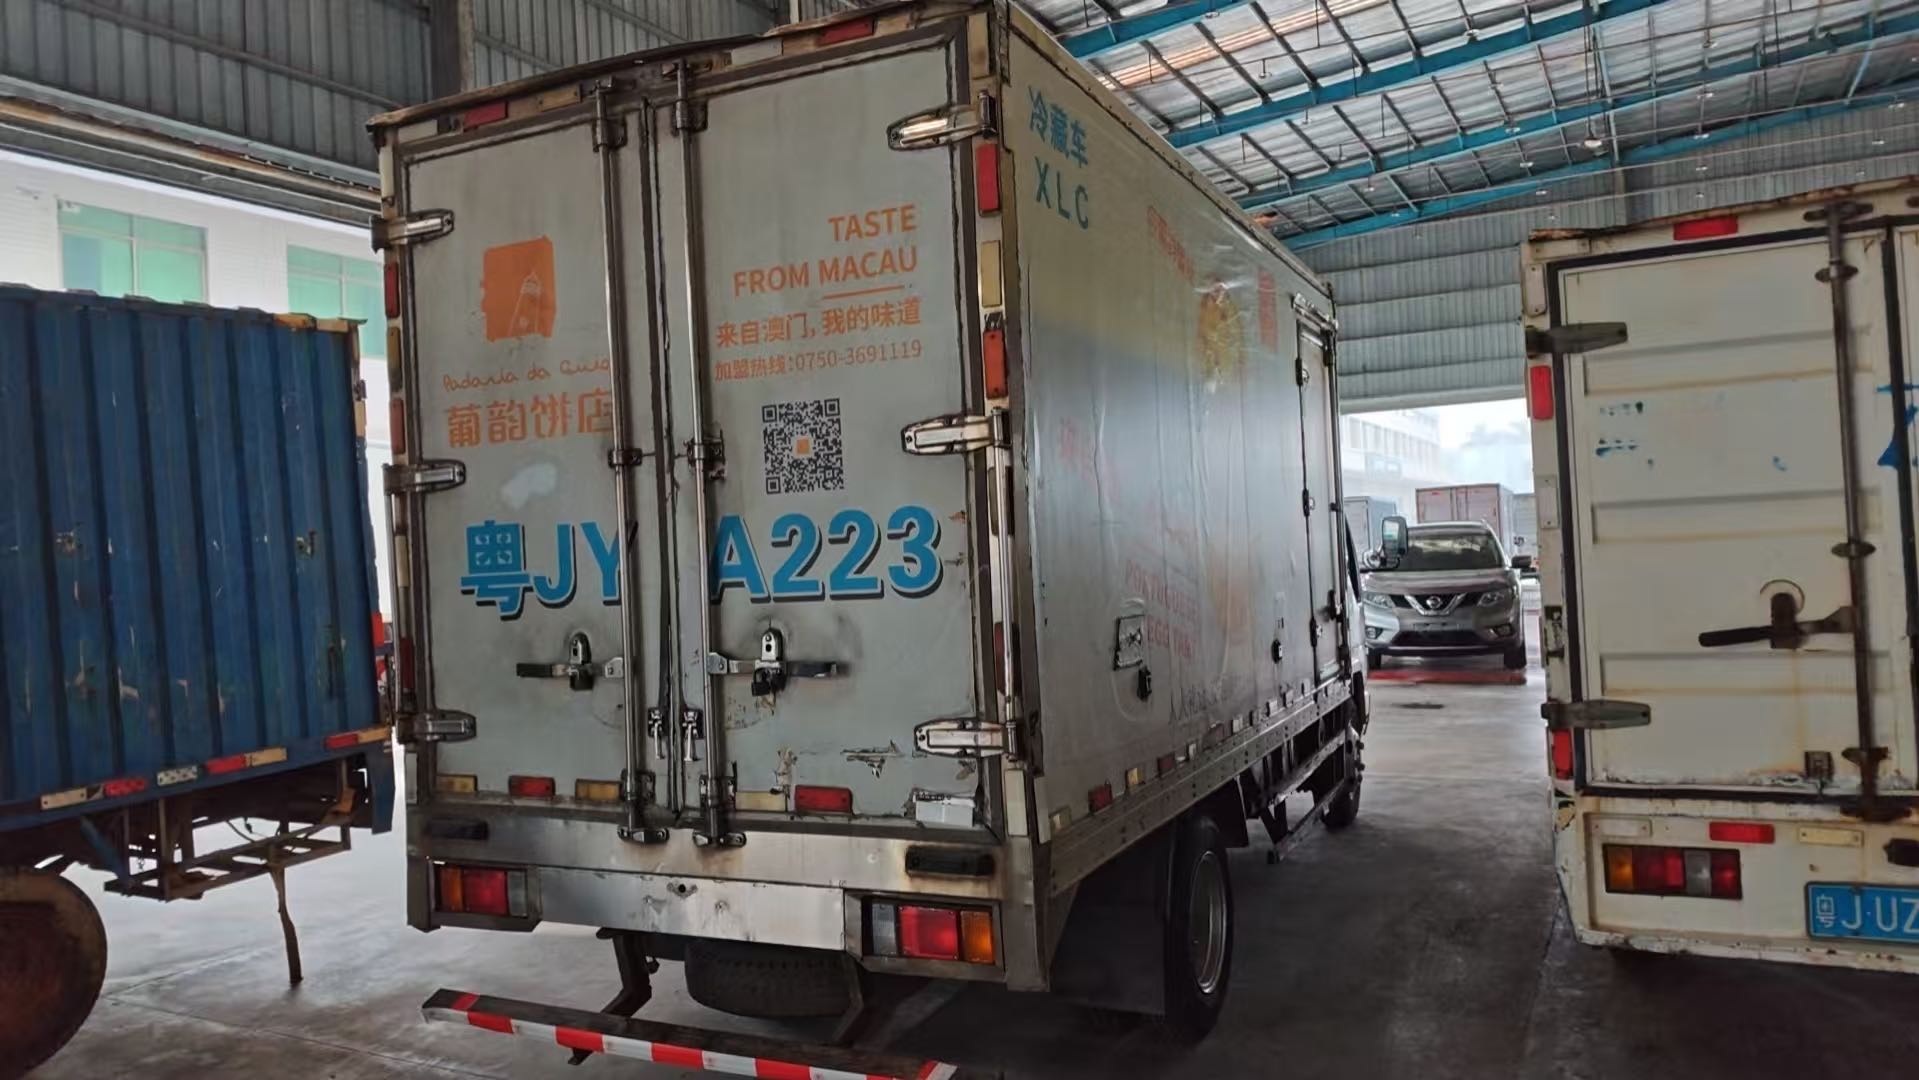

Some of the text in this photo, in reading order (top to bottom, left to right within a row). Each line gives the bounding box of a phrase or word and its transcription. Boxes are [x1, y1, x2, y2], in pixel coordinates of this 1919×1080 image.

[1028, 85, 1089, 168] 冷藏车
[828, 204, 918, 242] TASTE
[1034, 157, 1089, 230] XLC
[733, 246, 918, 297] FROM MACAU
[444, 386, 615, 449] 葡韵饼店
